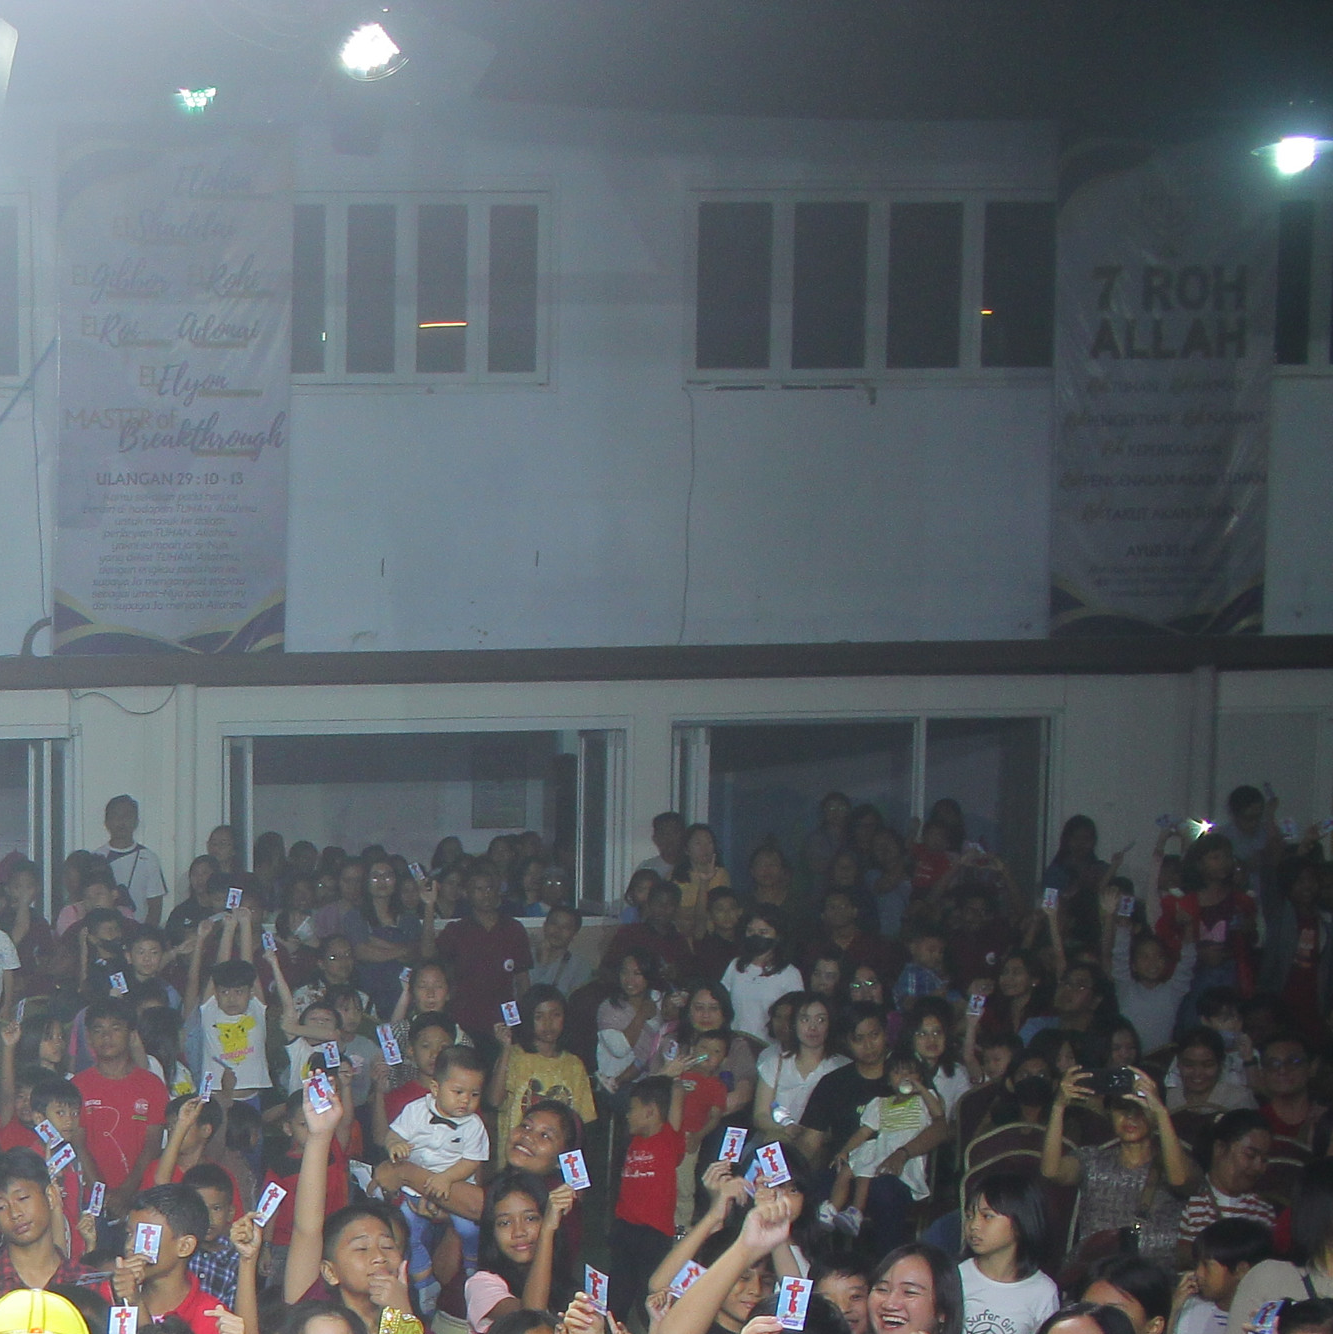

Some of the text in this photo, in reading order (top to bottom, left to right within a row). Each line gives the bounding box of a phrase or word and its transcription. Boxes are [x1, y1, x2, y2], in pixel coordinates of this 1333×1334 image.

[1093, 265, 1247, 311] 7 ROH
[1090, 318, 1247, 359] ALLAH
[65, 409, 151, 431] MASTER
[118, 411, 286, 462] Breakthrough
[96, 472, 173, 485] ULANGAN
[177, 472, 193, 485] 29
[230, 472, 244, 485] 13
[966, 1308, 1001, 1327] Surfer
